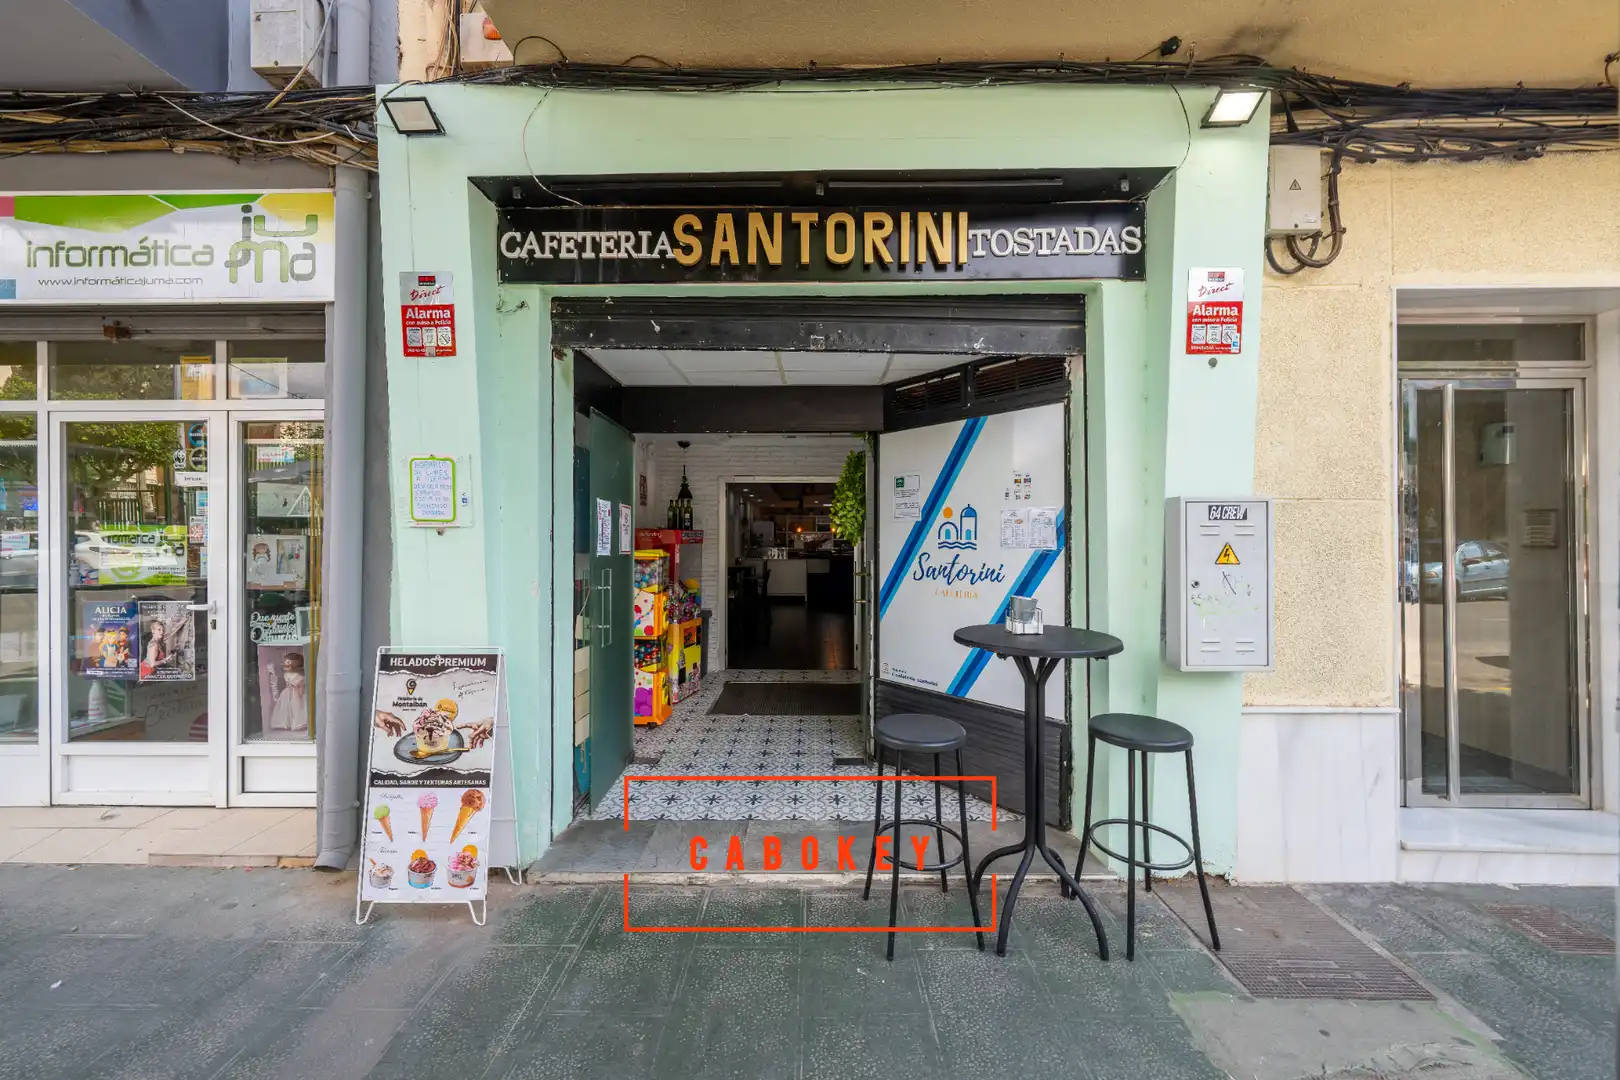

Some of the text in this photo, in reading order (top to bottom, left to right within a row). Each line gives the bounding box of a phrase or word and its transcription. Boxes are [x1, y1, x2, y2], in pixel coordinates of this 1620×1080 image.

[500, 211, 1142, 265] CAFETERIA SANTORINI TOSTADAS
[26, 236, 214, 268] informática
[38, 276, 203, 286] www.informáticajuma.com
[406, 307, 451, 319] Alarma
[1193, 304, 1238, 316] Alarma
[913, 552, 1005, 585] Santorini
[95, 606, 127, 614] ALICIA
[390, 658, 486, 667] HELADOS PREMIUM
